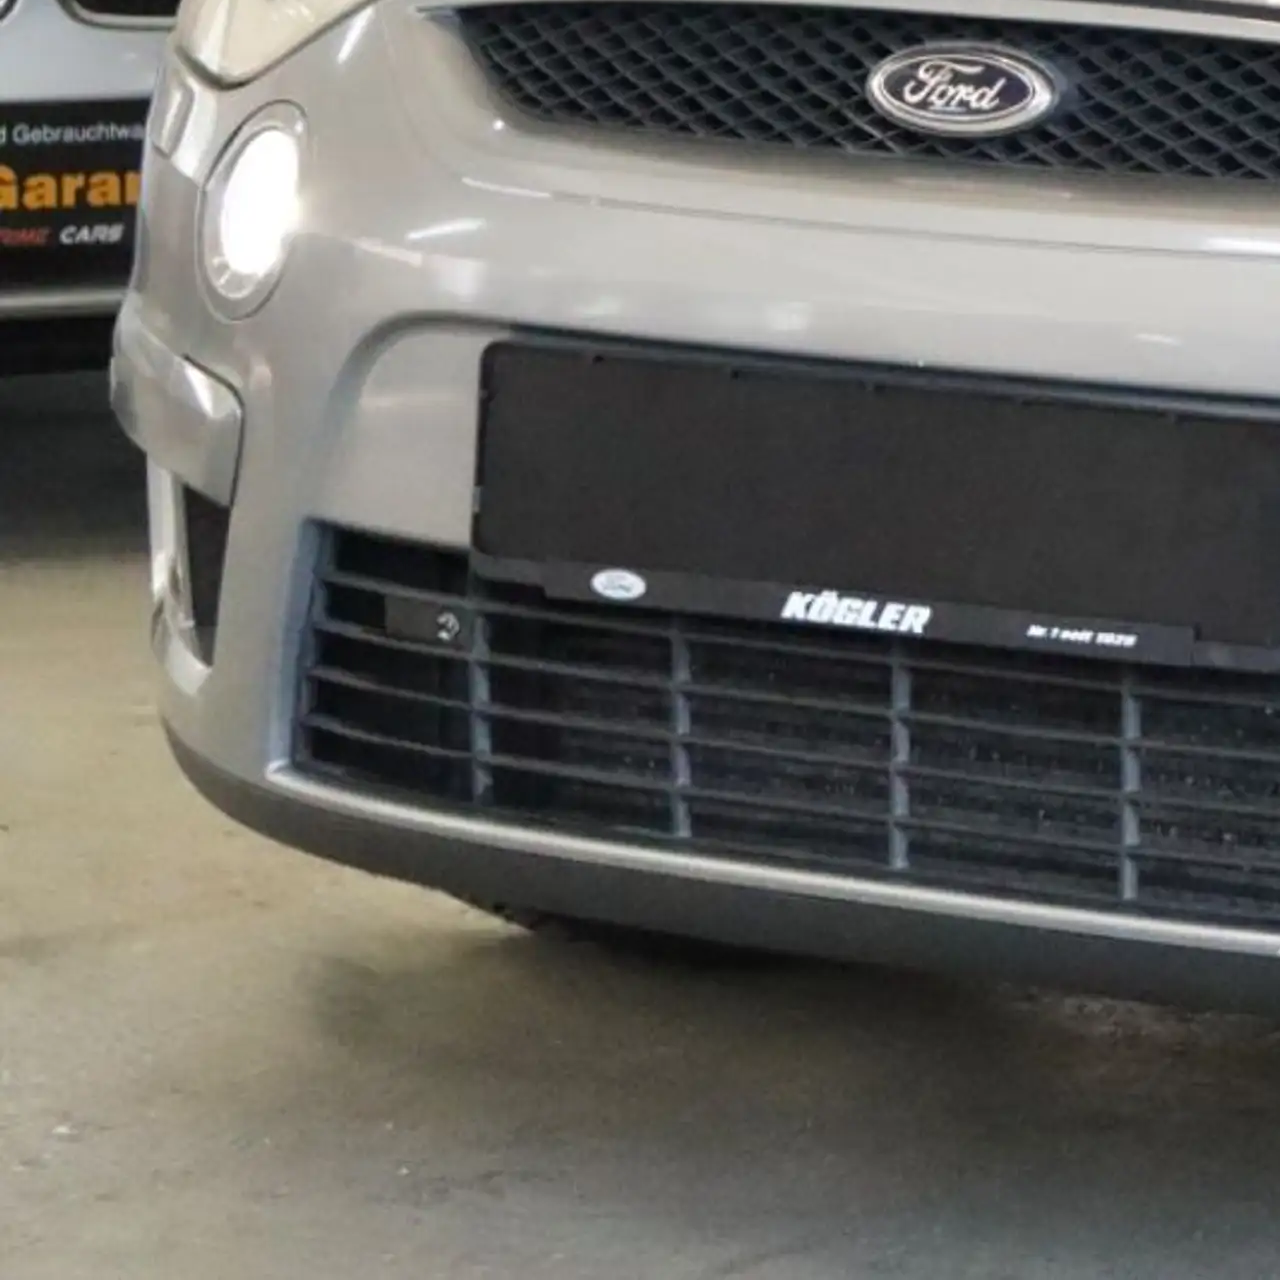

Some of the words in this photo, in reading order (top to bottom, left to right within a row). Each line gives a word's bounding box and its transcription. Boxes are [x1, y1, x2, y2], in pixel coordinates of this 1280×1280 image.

[903, 60, 1006, 112] Ford
[59, 223, 124, 245] CARS
[780, 590, 932, 634] KÖGLER
